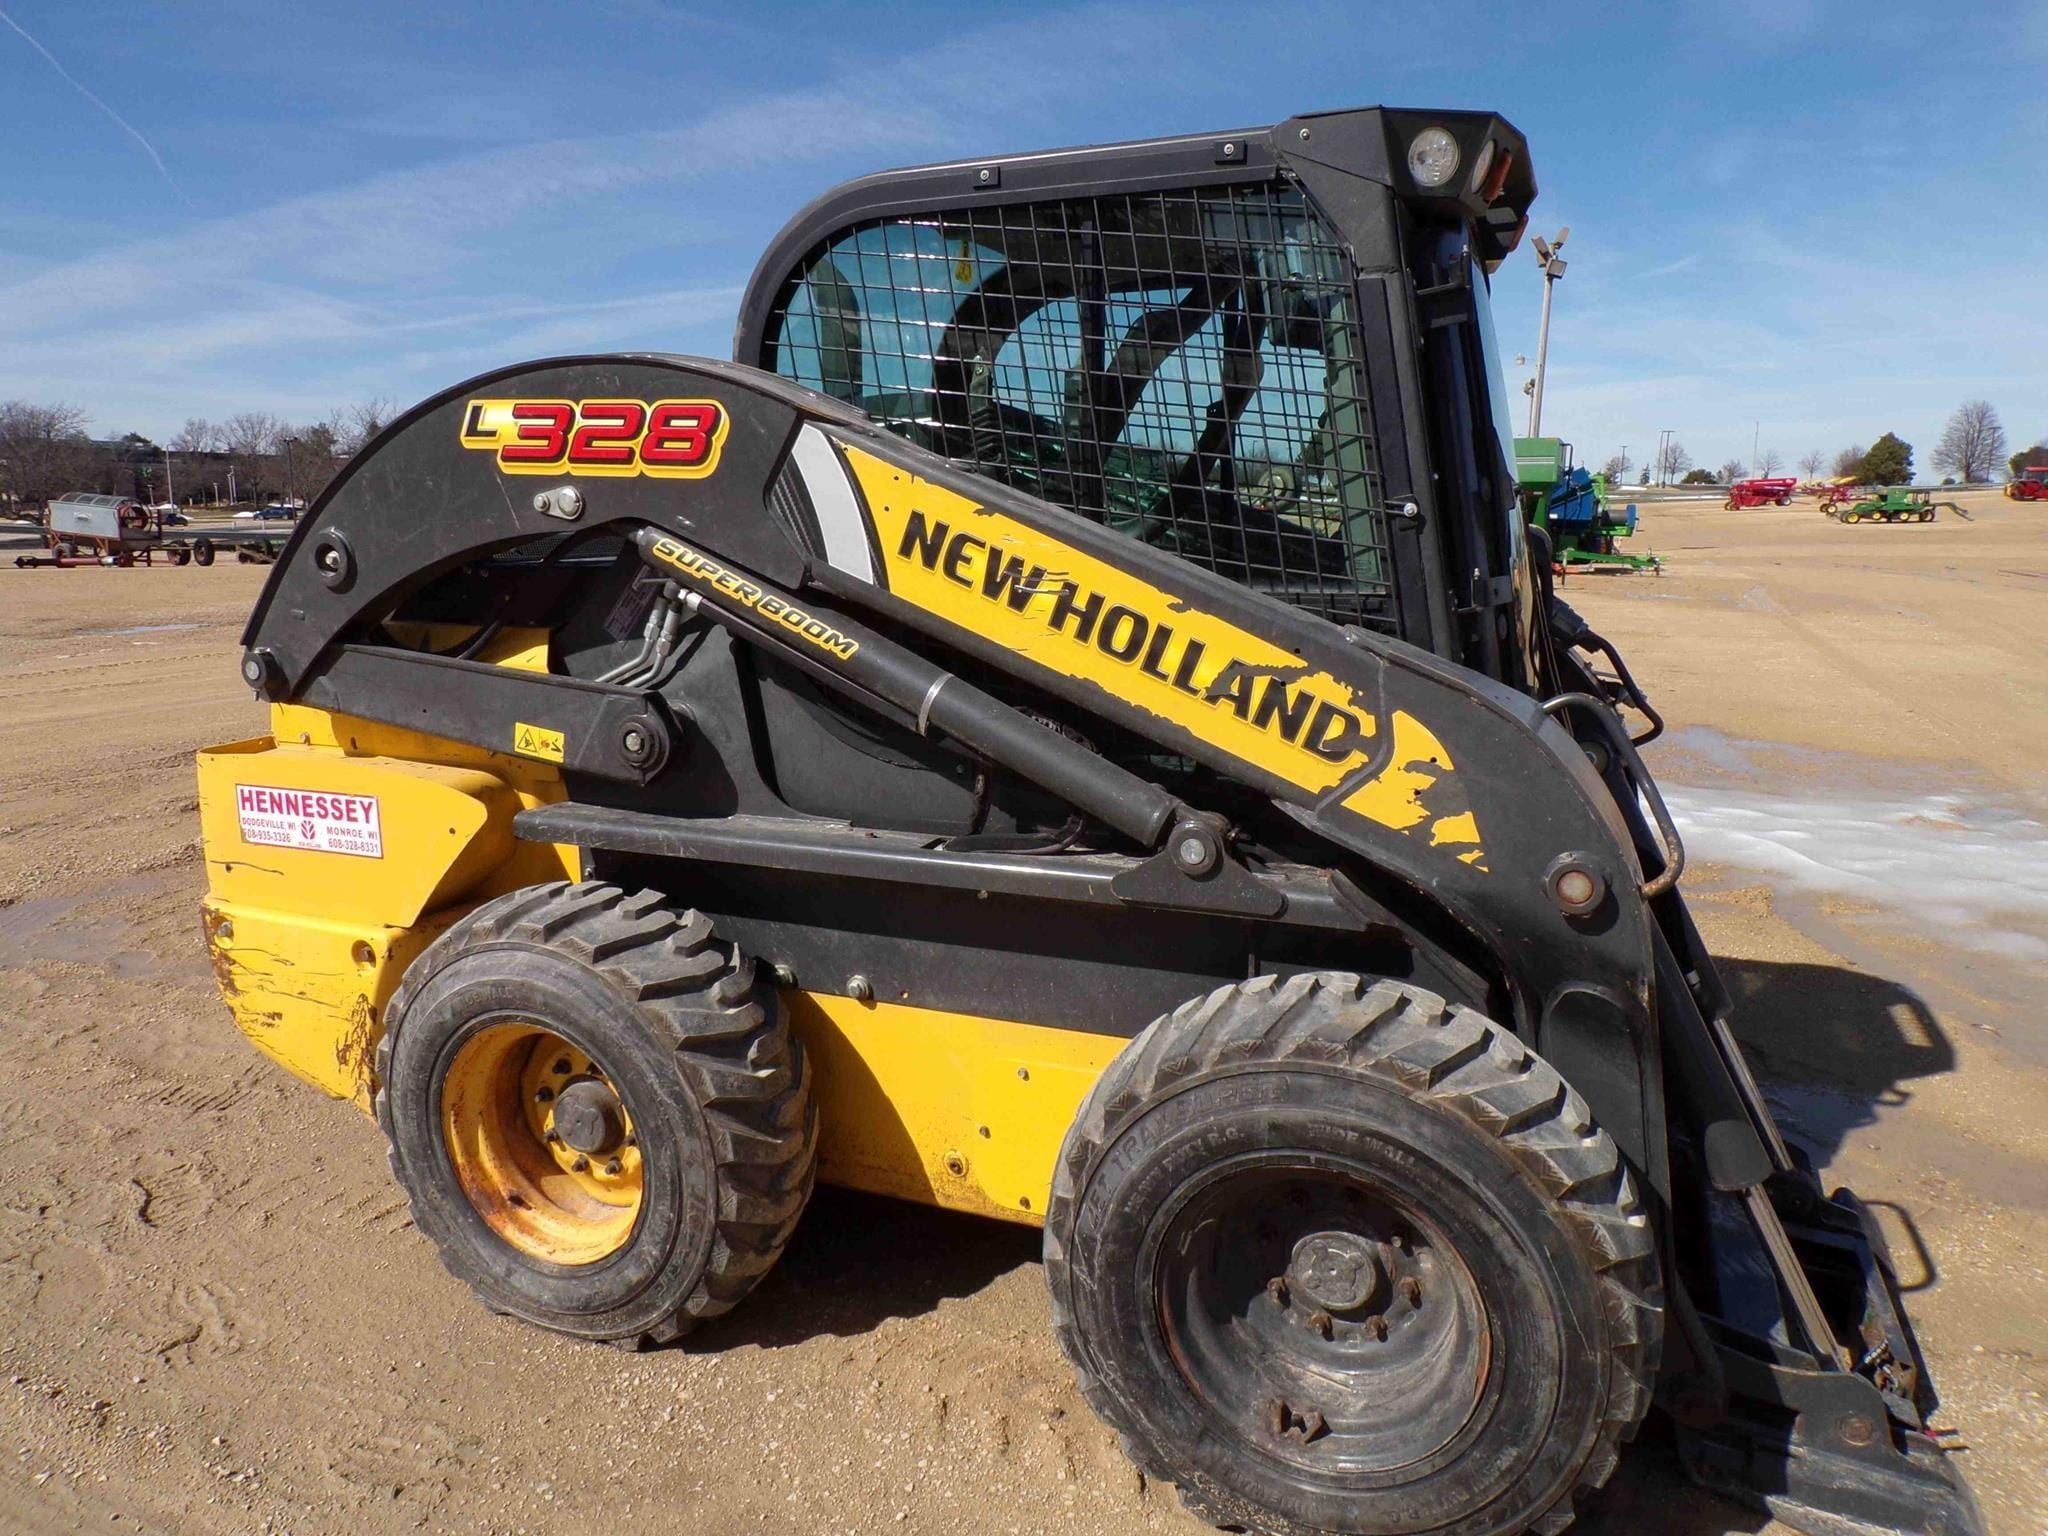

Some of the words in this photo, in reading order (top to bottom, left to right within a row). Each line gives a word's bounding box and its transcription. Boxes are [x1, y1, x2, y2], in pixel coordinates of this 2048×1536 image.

[652, 537, 762, 607] SUPER
[756, 594, 860, 661] BOOM
[897, 509, 1047, 613] NEW
[1047, 580, 1364, 767] HOLLAND
[240, 788, 373, 825] HENNESSEY
[367, 831, 378, 841] WI
